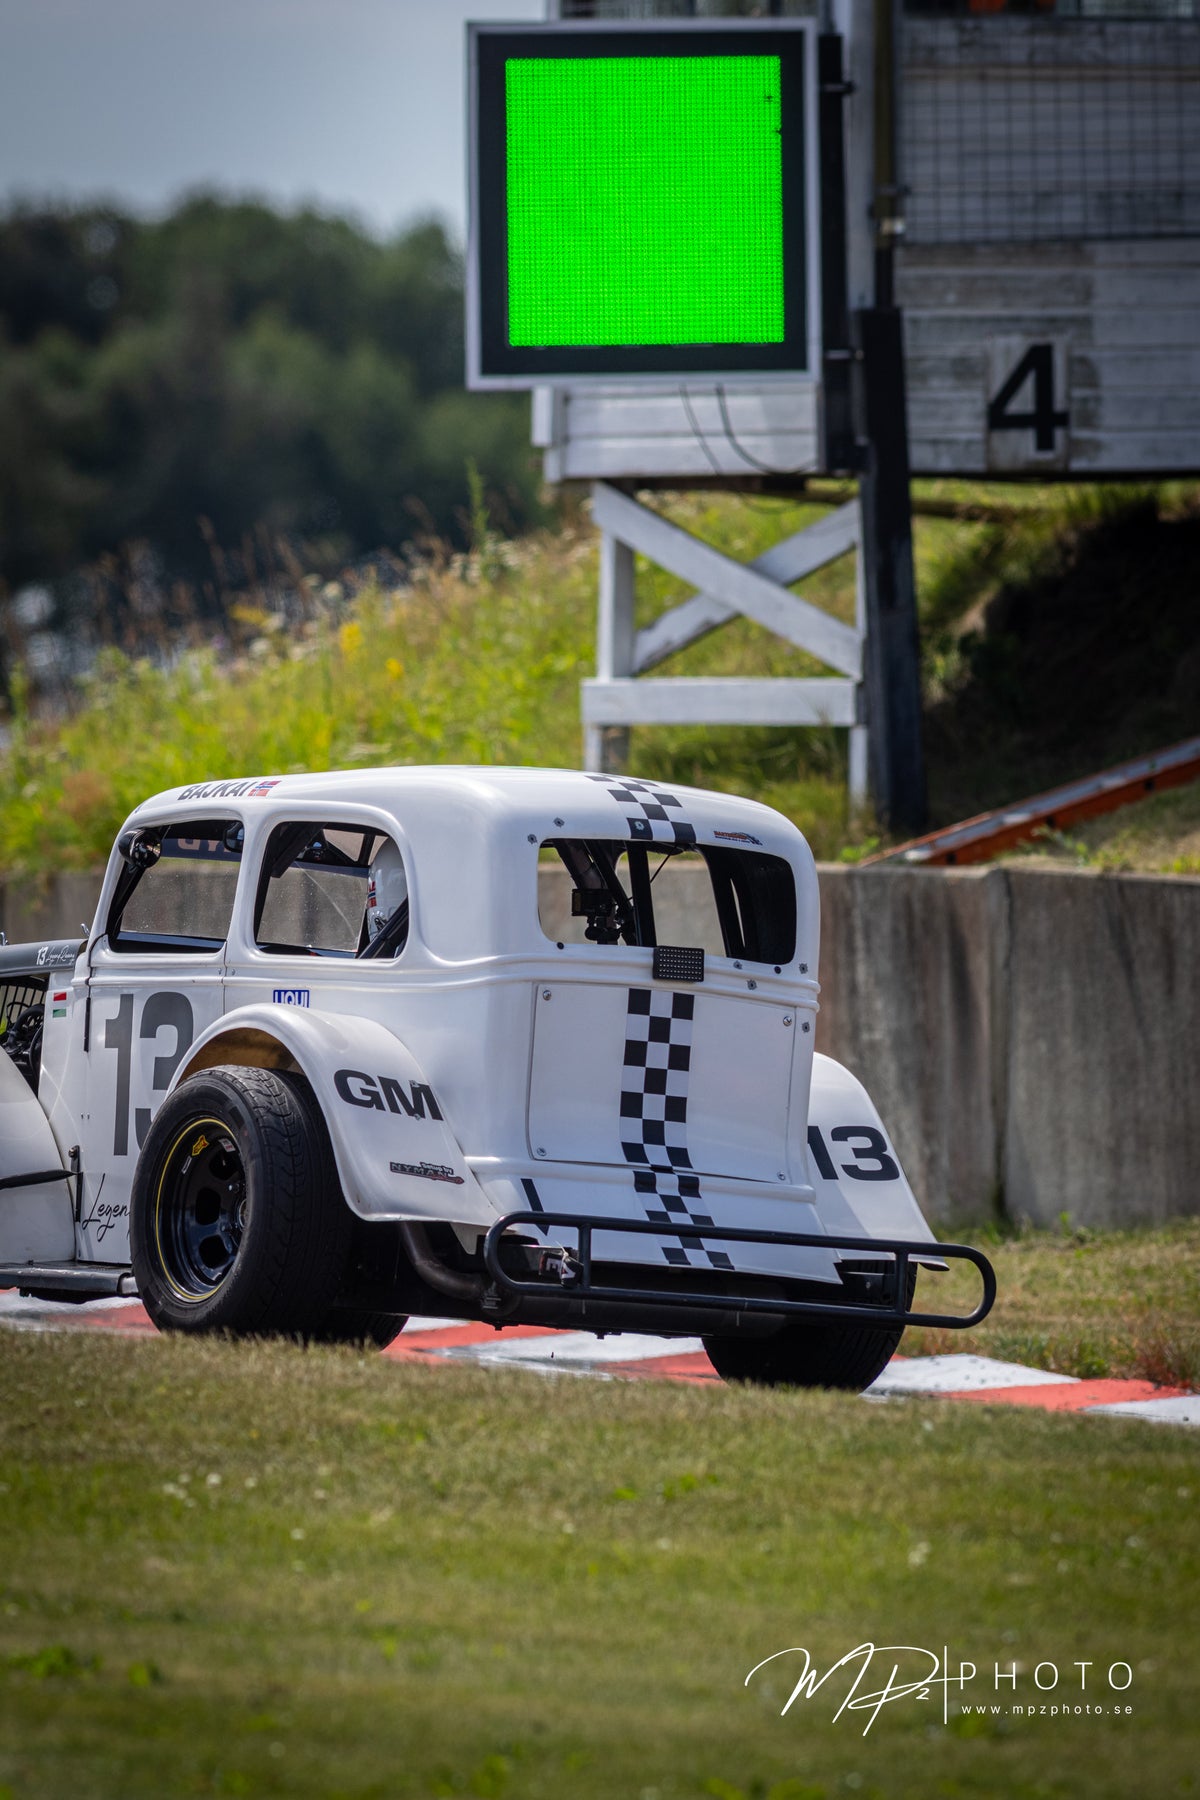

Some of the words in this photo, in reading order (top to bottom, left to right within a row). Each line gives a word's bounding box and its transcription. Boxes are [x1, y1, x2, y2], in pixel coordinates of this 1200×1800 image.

[988, 344, 1070, 451] 4
[177, 781, 258, 800] BAJKAI
[36, 946, 48, 965] 13
[105, 991, 194, 1156] 13
[333, 1068, 444, 1121] GM
[807, 1125, 900, 1181] 13
[82, 1172, 130, 1242] Legen
